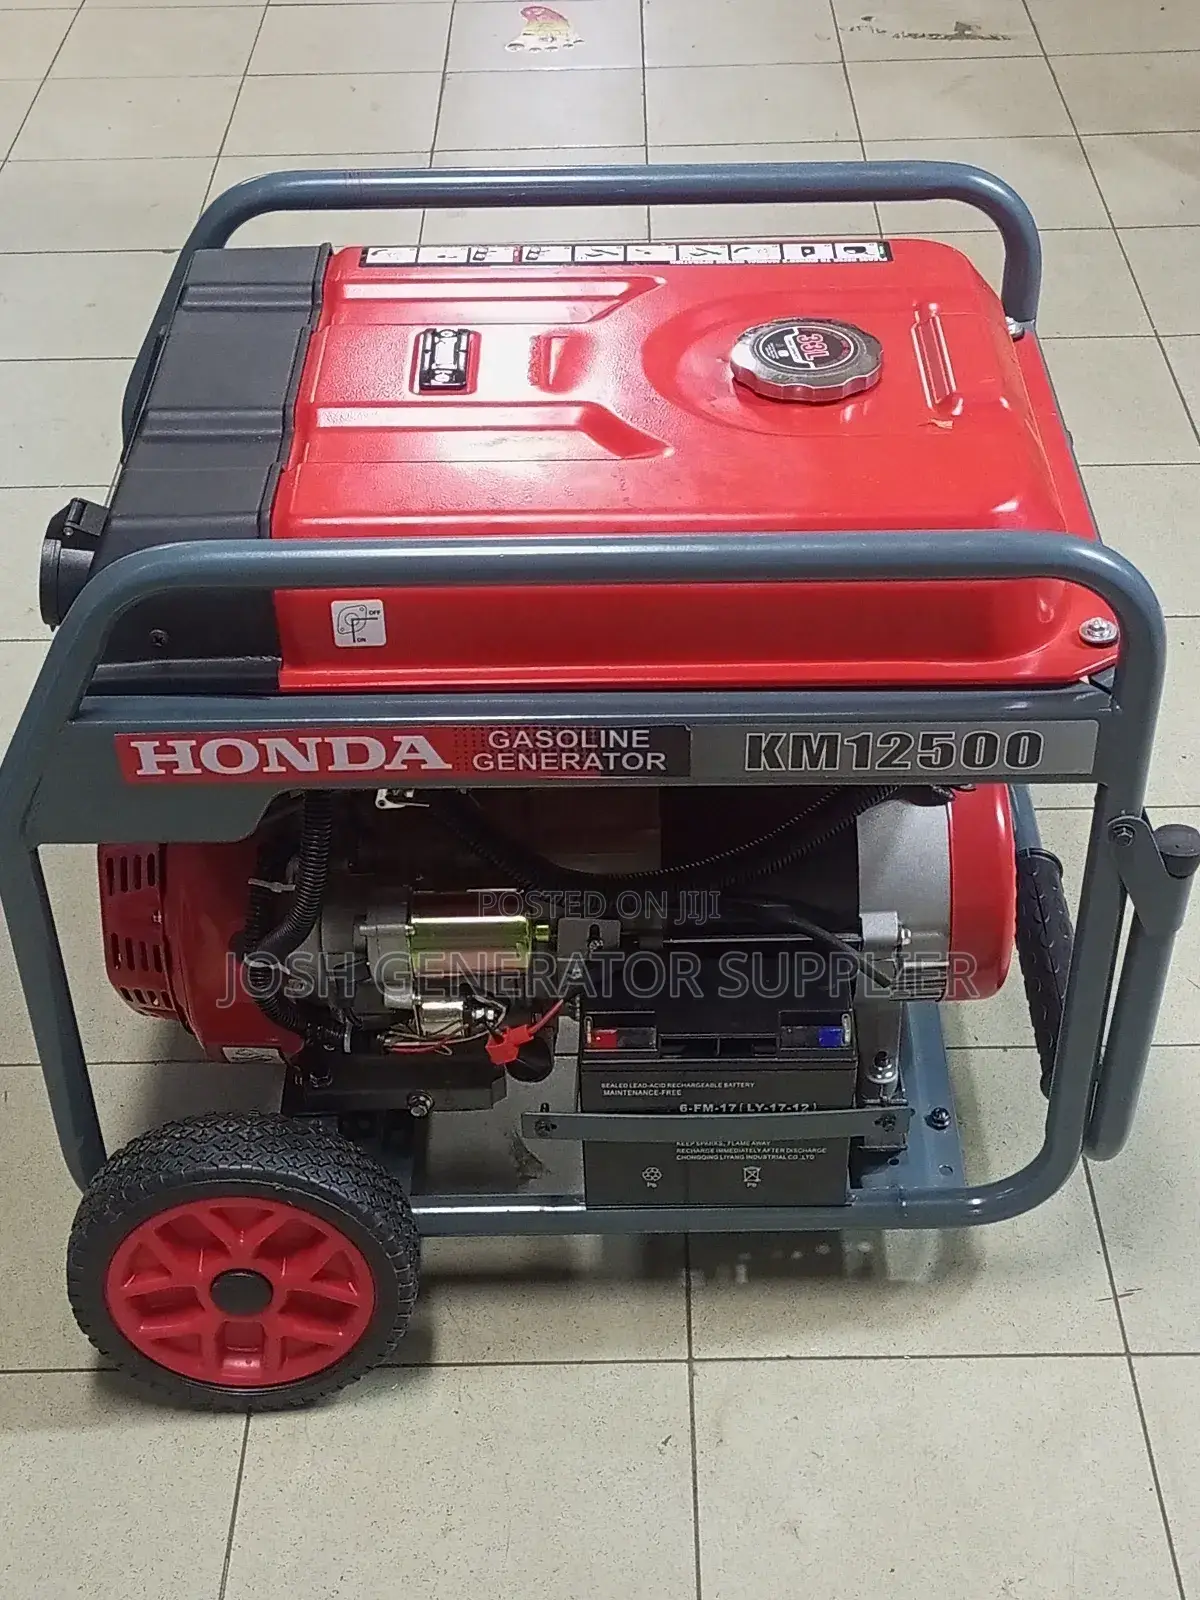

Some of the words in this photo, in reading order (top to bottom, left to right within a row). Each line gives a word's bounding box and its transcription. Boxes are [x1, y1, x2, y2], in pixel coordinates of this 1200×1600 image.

[797, 333, 830, 361] 33L
[488, 729, 650, 749] GASOLINE
[744, 729, 1045, 772] KM12500
[130, 735, 453, 776] HONDA
[472, 752, 667, 772] GENERATOR
